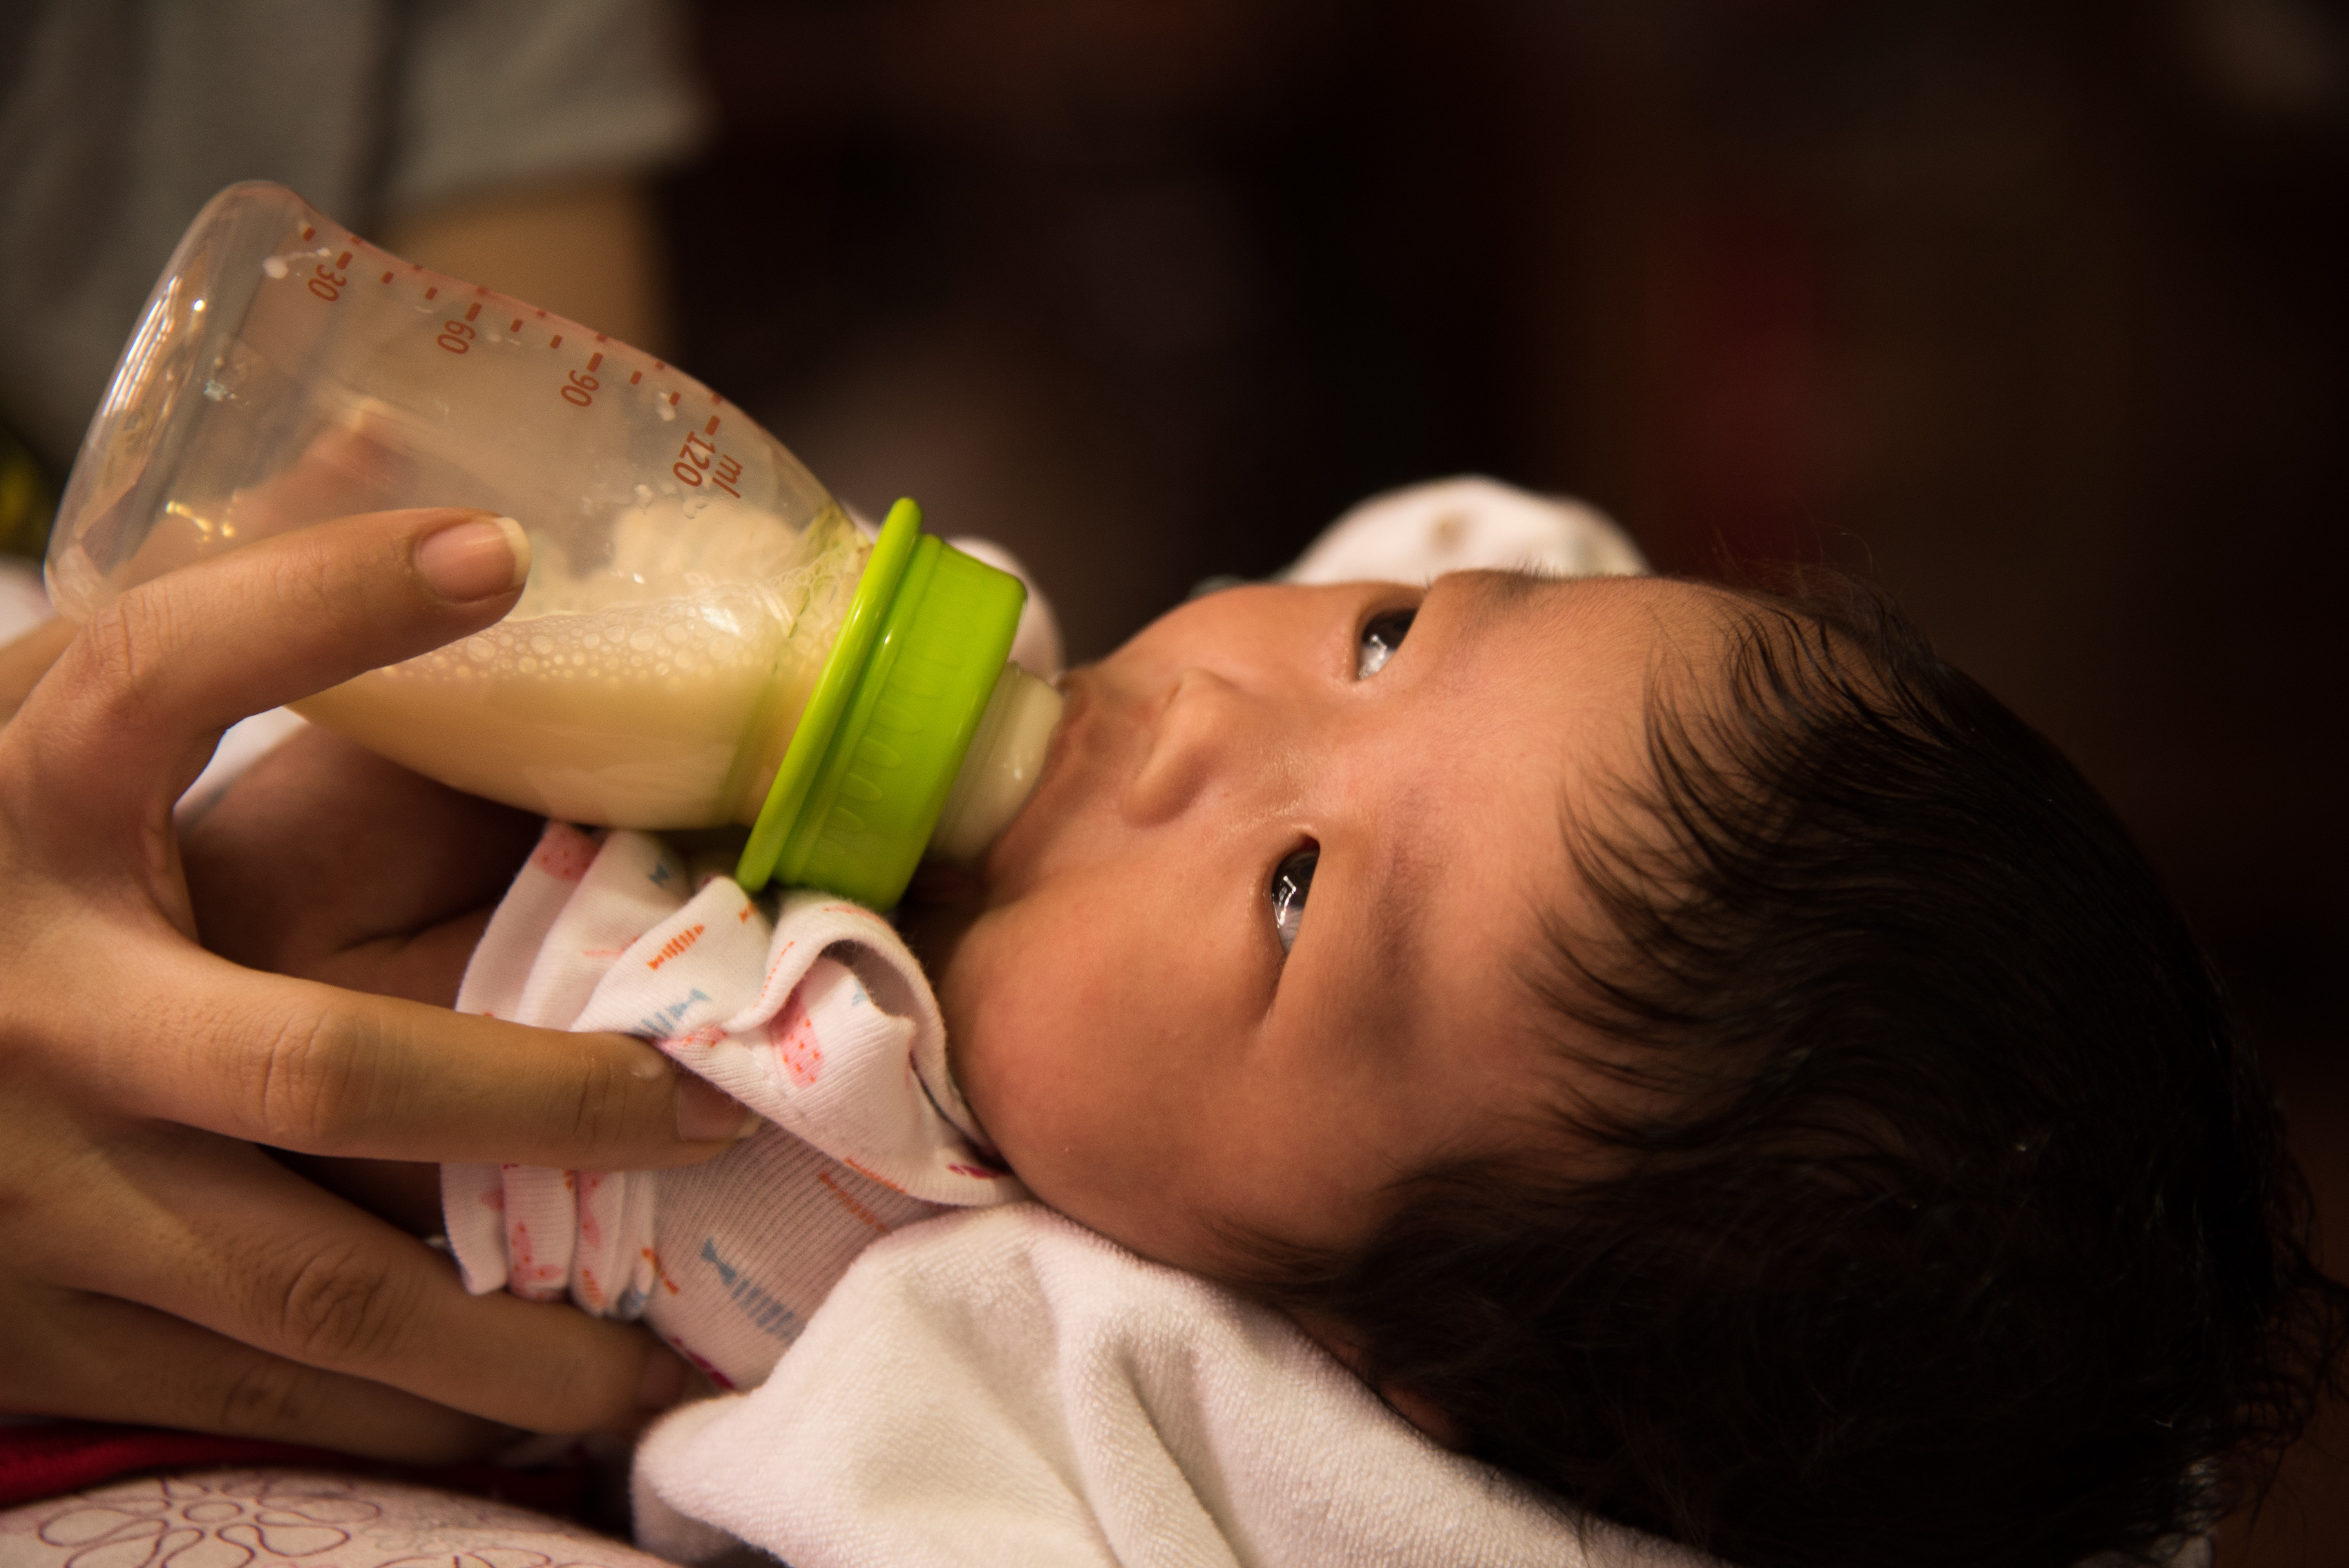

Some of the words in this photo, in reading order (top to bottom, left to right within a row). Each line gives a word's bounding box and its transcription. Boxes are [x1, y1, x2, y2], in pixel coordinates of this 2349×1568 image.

[308, 264, 347, 301] 30
[437, 320, 476, 354] 60
[561, 370, 599, 407] 90
[673, 431, 716, 487] 120
[712, 454, 743, 498] ml
